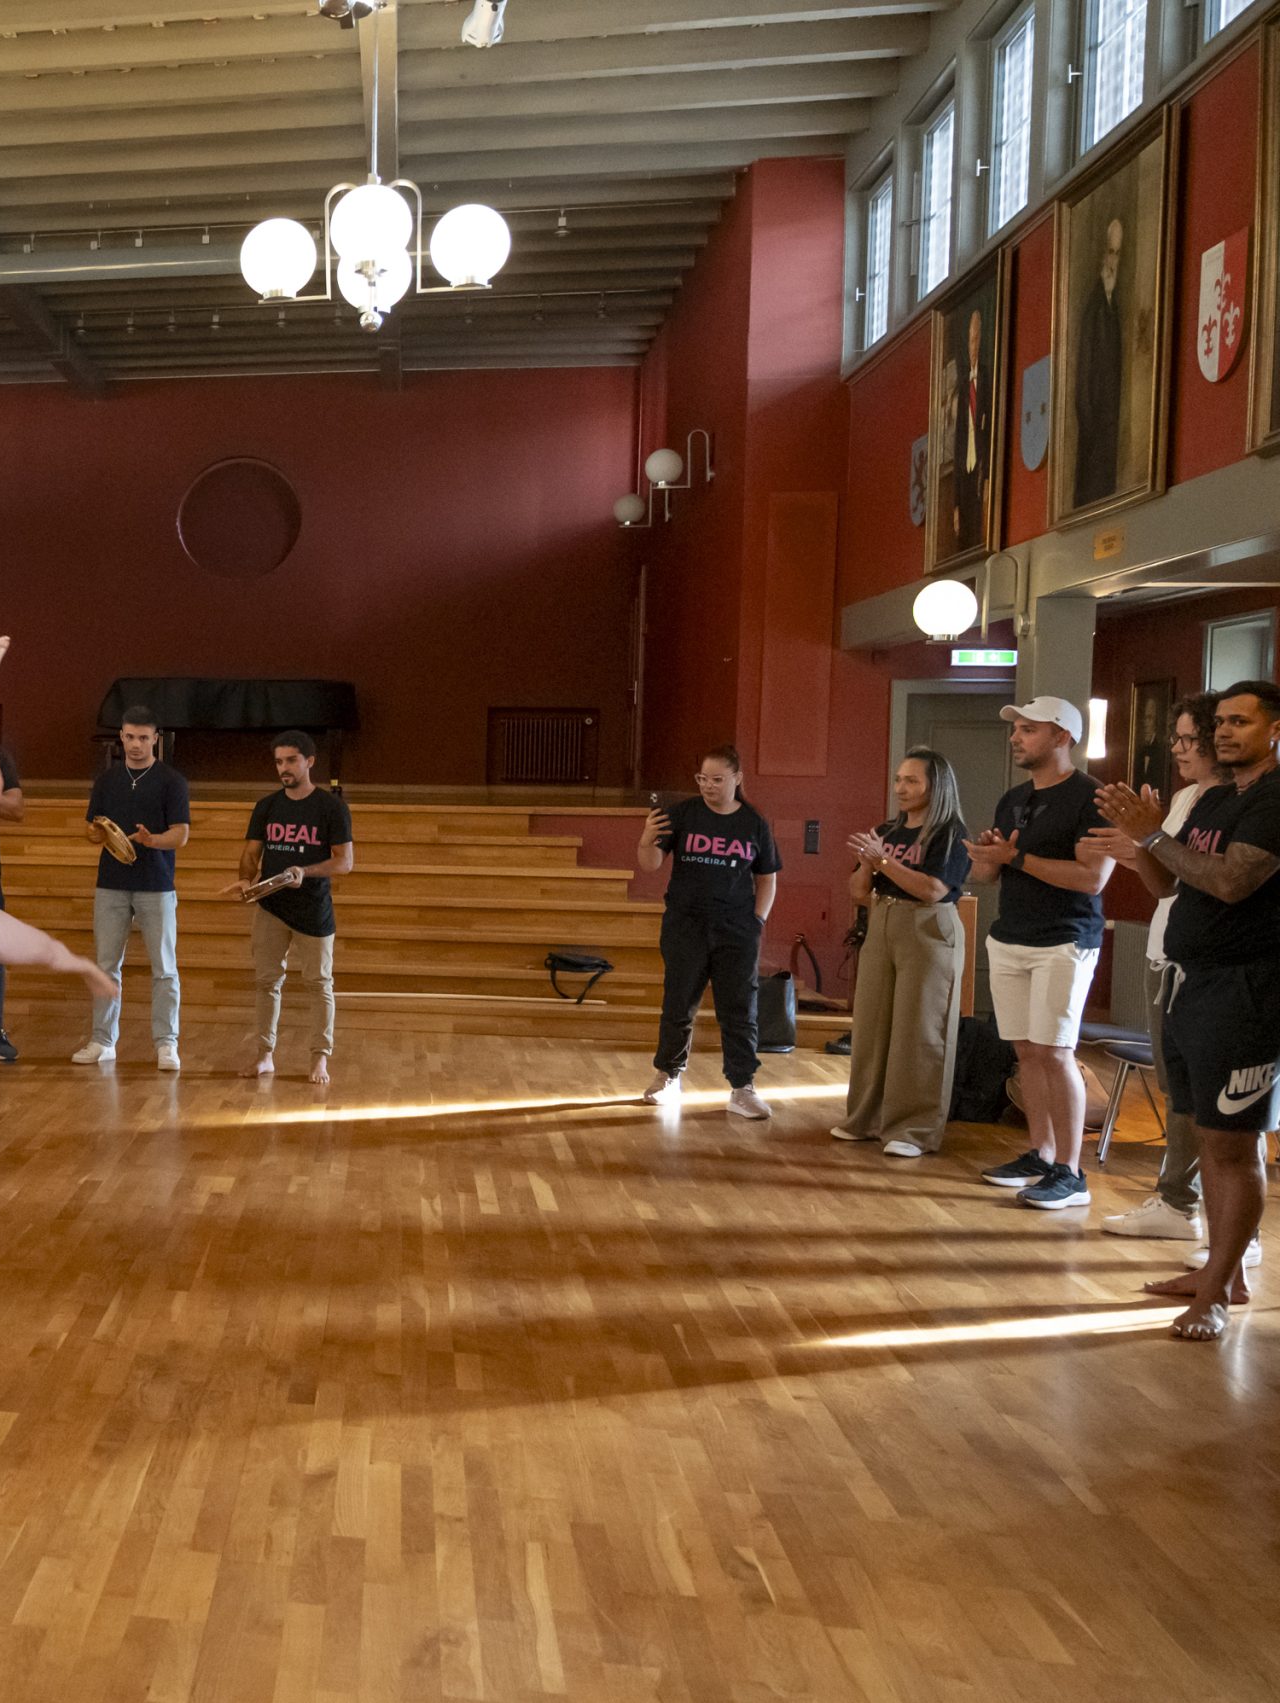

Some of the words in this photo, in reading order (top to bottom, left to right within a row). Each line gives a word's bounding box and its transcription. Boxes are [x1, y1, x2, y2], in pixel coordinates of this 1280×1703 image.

[266, 822, 322, 846] IDEAL
[685, 833, 754, 861] IDEAL
[681, 855, 727, 867] CAPOEIRA
